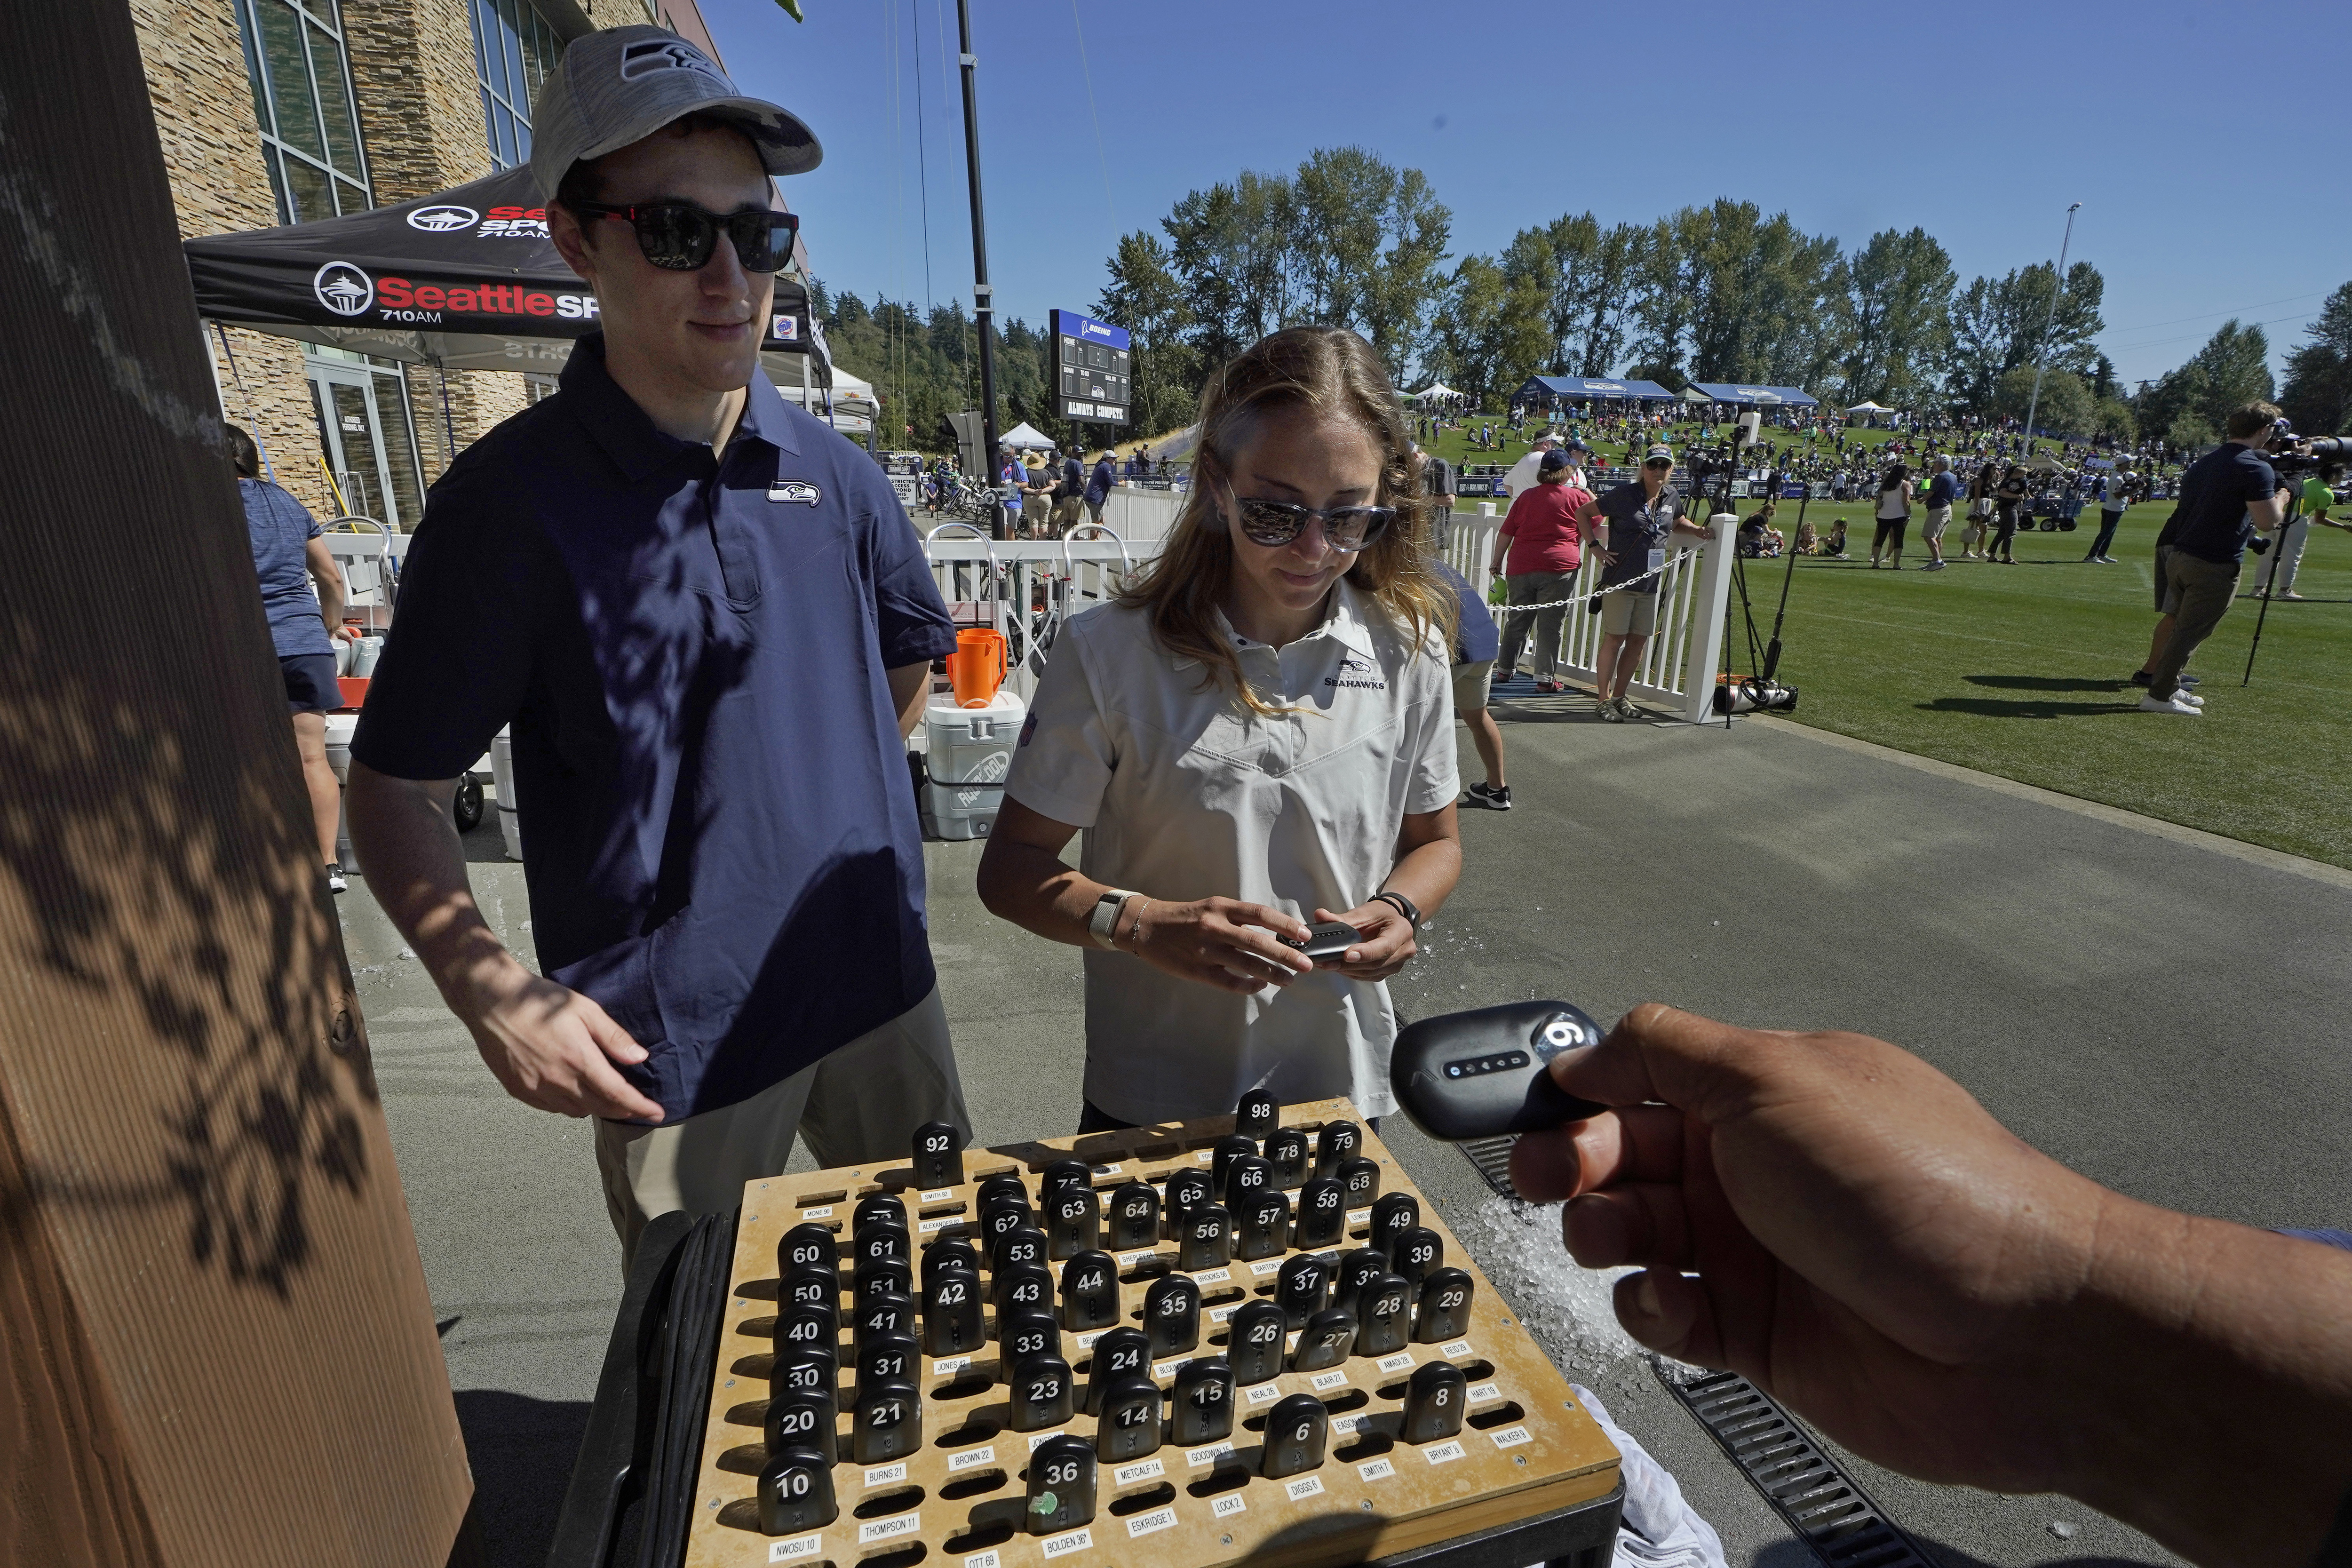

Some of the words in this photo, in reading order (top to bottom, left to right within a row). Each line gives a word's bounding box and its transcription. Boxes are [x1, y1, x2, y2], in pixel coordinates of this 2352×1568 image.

[380, 309, 441, 323] 710AM
[1089, 324, 1111, 336] BOEING
[1064, 337, 1075, 345] HOME
[1068, 402, 1093, 416] ALWAYS
[1097, 405, 1123, 420] COMPETE
[1324, 677, 1385, 690] SEAHAWKS
[1252, 1104, 1270, 1118] 98
[926, 1136, 948, 1152] 92
[1335, 1136, 1353, 1151] 79
[1279, 1145, 1298, 1160] 78
[1241, 1171, 1263, 1186] 66
[1350, 1176, 1369, 1191] 68
[1180, 1188, 1202, 1203] 65
[1317, 1193, 1338, 1208] 58
[1062, 1200, 1085, 1218] 63
[1126, 1202, 1148, 1217] 64
[1258, 1208, 1280, 1224] 57
[923, 1220, 952, 1230] ALEXANDER
[995, 1215, 1019, 1233] 62
[1390, 1211, 1410, 1228] 49
[1196, 1223, 1219, 1239] 56
[793, 1246, 819, 1263] 60
[870, 1241, 893, 1257] 61
[1010, 1244, 1034, 1261] 53
[1411, 1245, 1433, 1263] 39
[1255, 1263, 1276, 1272] BARTON
[1077, 1271, 1103, 1290] 44
[1198, 1274, 1219, 1282] BROOKS
[1295, 1272, 1319, 1291] 37
[795, 1284, 821, 1302] 50
[870, 1279, 894, 1295] 51
[938, 1284, 966, 1305] 42
[1013, 1284, 1039, 1302] 43
[1161, 1296, 1187, 1316] 35
[1376, 1297, 1400, 1315] 28
[1439, 1291, 1463, 1307] 29
[869, 1313, 896, 1329] 41
[789, 1322, 818, 1341] 40
[1250, 1324, 1277, 1343] 26
[1321, 1332, 1349, 1347] 27
[1017, 1334, 1044, 1353] 33
[1445, 1345, 1459, 1355] REID
[874, 1357, 902, 1375] 31
[938, 1361, 957, 1371] JONES
[1111, 1349, 1139, 1371] 24
[1384, 1359, 1403, 1369] AMADI
[789, 1369, 818, 1388] 30
[1317, 1376, 1333, 1387] BLAIR
[1334, 1374, 1341, 1383] 27
[1030, 1380, 1059, 1401] 23
[1195, 1385, 1222, 1404] 15
[1251, 1389, 1267, 1400] NEAL
[1436, 1388, 1448, 1406] 8
[1470, 1388, 1487, 1399] HART
[1488, 1386, 1495, 1395] 19
[872, 1403, 900, 1425] 21
[1122, 1406, 1149, 1425] 14
[783, 1411, 814, 1434] 20
[1336, 1418, 1357, 1429] EASON
[1358, 1417, 1365, 1425] 17
[1295, 1423, 1310, 1441] 6
[1494, 1432, 1520, 1445] WALKER
[1521, 1430, 1526, 1439] 9
[955, 1452, 980, 1465] BROWN
[982, 1450, 989, 1459] 22
[1192, 1449, 1222, 1462] GOODWIN
[1223, 1446, 1231, 1455] 15
[1428, 1448, 1452, 1460] BRYANT
[1454, 1445, 1460, 1454] 8
[869, 1471, 893, 1481] BURNS
[894, 1467, 902, 1477] 21
[1046, 1462, 1078, 1484] 36
[1120, 1468, 1150, 1480] METCALF
[1363, 1465, 1383, 1476] SMITH
[1384, 1463, 1389, 1472] 7
[776, 1474, 809, 1498] 10
[1291, 1482, 1311, 1495] DIGGS
[1313, 1480, 1318, 1489] 6
[1216, 1500, 1234, 1512] LOCK
[1235, 1498, 1240, 1508] 2
[865, 1520, 906, 1537] THOMPSON
[908, 1518, 915, 1528] 11
[1132, 1515, 1167, 1532] ESKRIDGE
[1168, 1512, 1172, 1521] 1
[776, 1541, 805, 1556] NWOSU
[806, 1539, 815, 1549] 10
[1048, 1538, 1076, 1553] BOLDEN
[969, 1557, 983, 1568] OTT
[985, 1555, 994, 1566] 69
